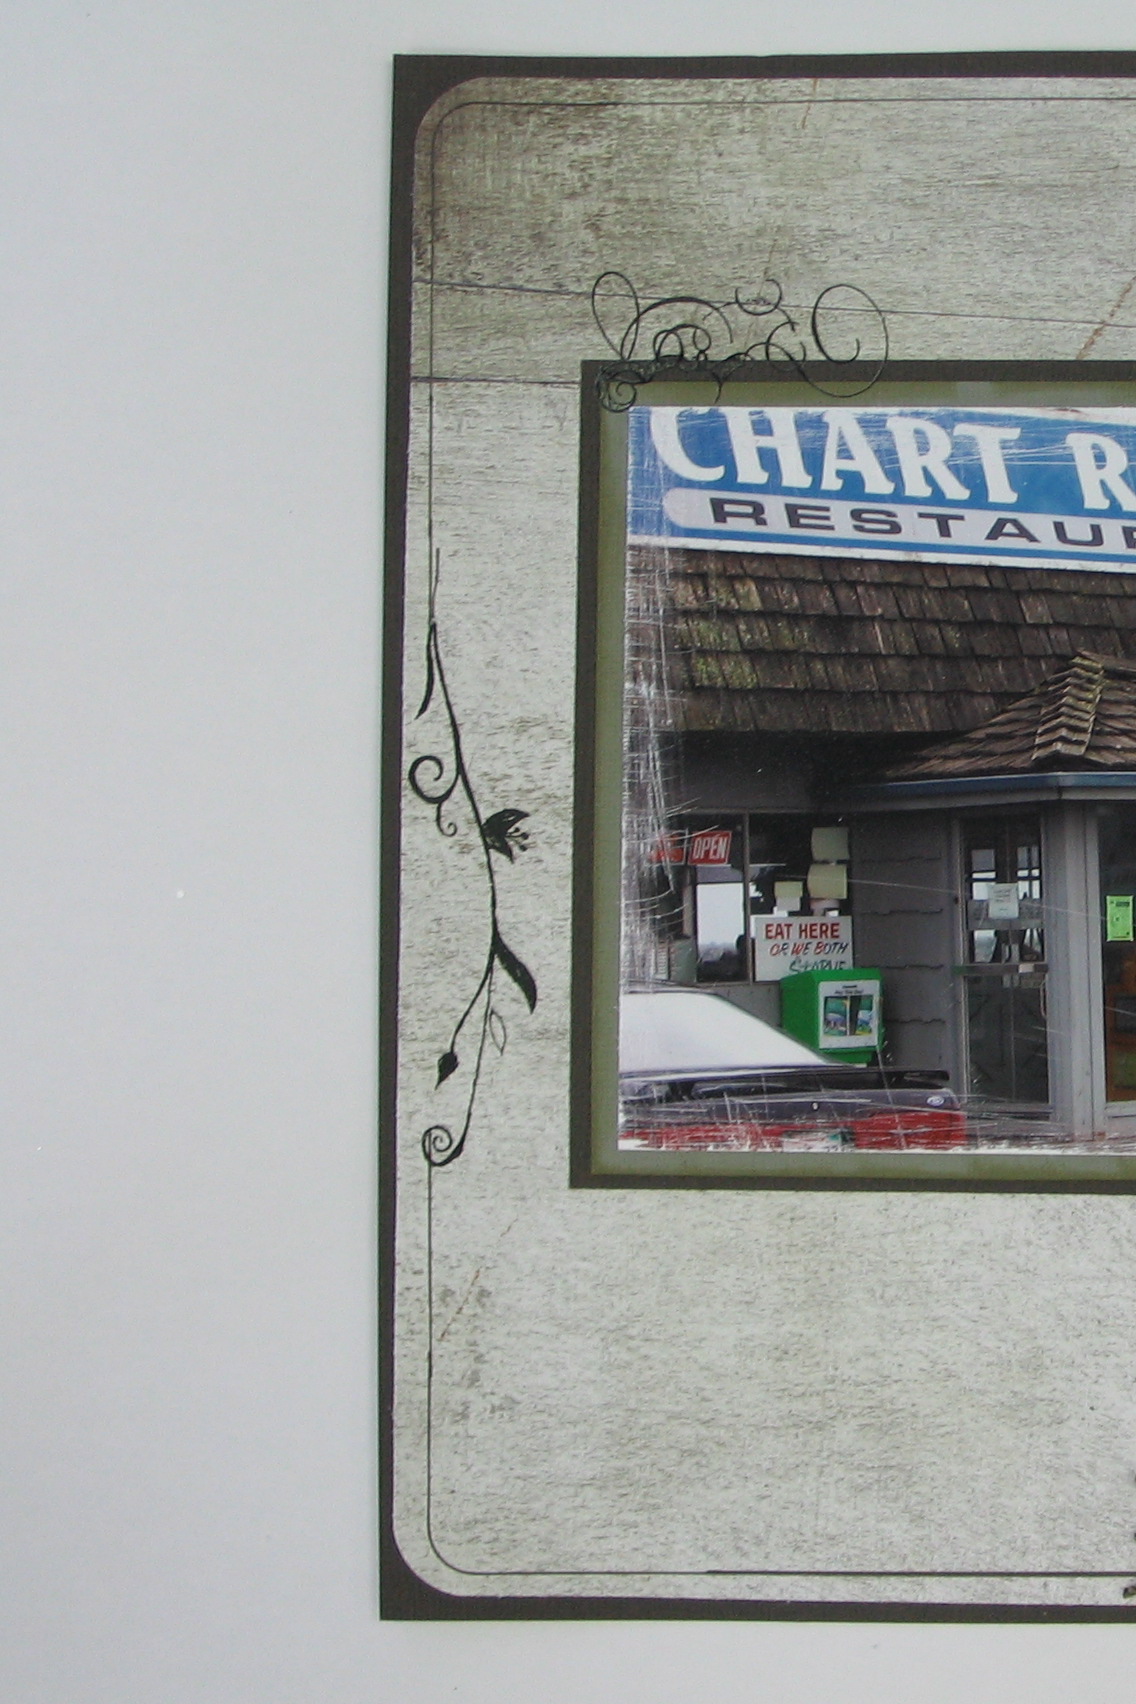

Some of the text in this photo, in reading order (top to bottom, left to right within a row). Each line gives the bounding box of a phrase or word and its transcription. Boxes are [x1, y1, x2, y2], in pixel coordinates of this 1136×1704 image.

[651, 407, 1021, 504] CHART
[692, 836, 729, 860] OPEN
[765, 922, 840, 940] EAT HERE
[791, 942, 811, 956] WE
[814, 941, 848, 955] BOTH
